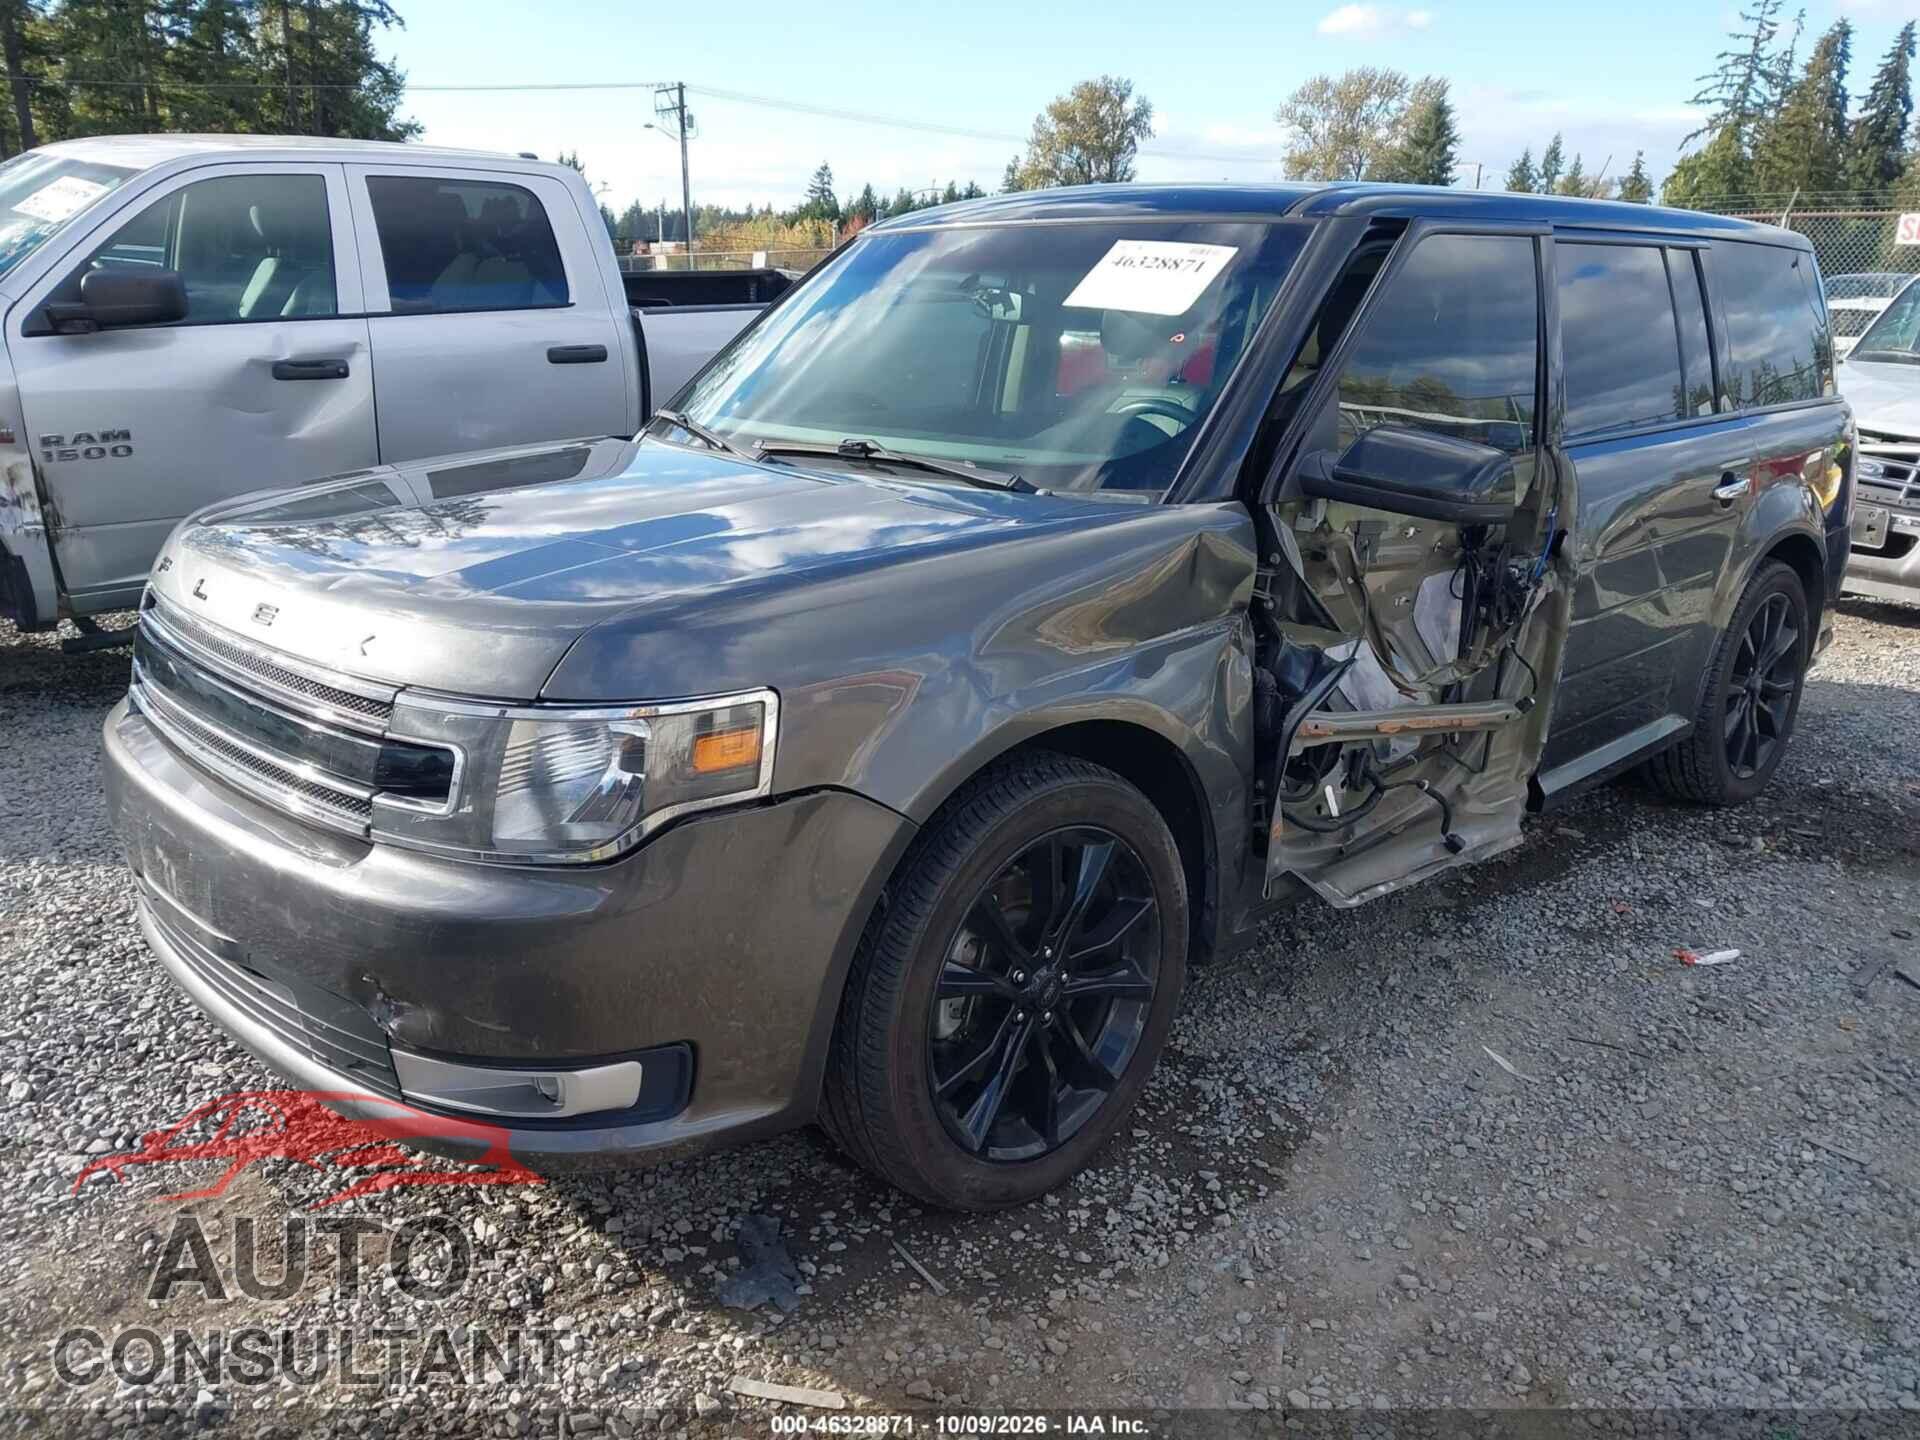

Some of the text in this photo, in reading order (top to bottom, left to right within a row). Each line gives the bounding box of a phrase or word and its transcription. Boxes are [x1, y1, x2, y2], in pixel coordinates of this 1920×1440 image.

[1901, 217, 1920, 241] S
[1112, 255, 1206, 272] 46328871
[40, 429, 131, 447] RAM
[40, 445, 133, 463] 1500
